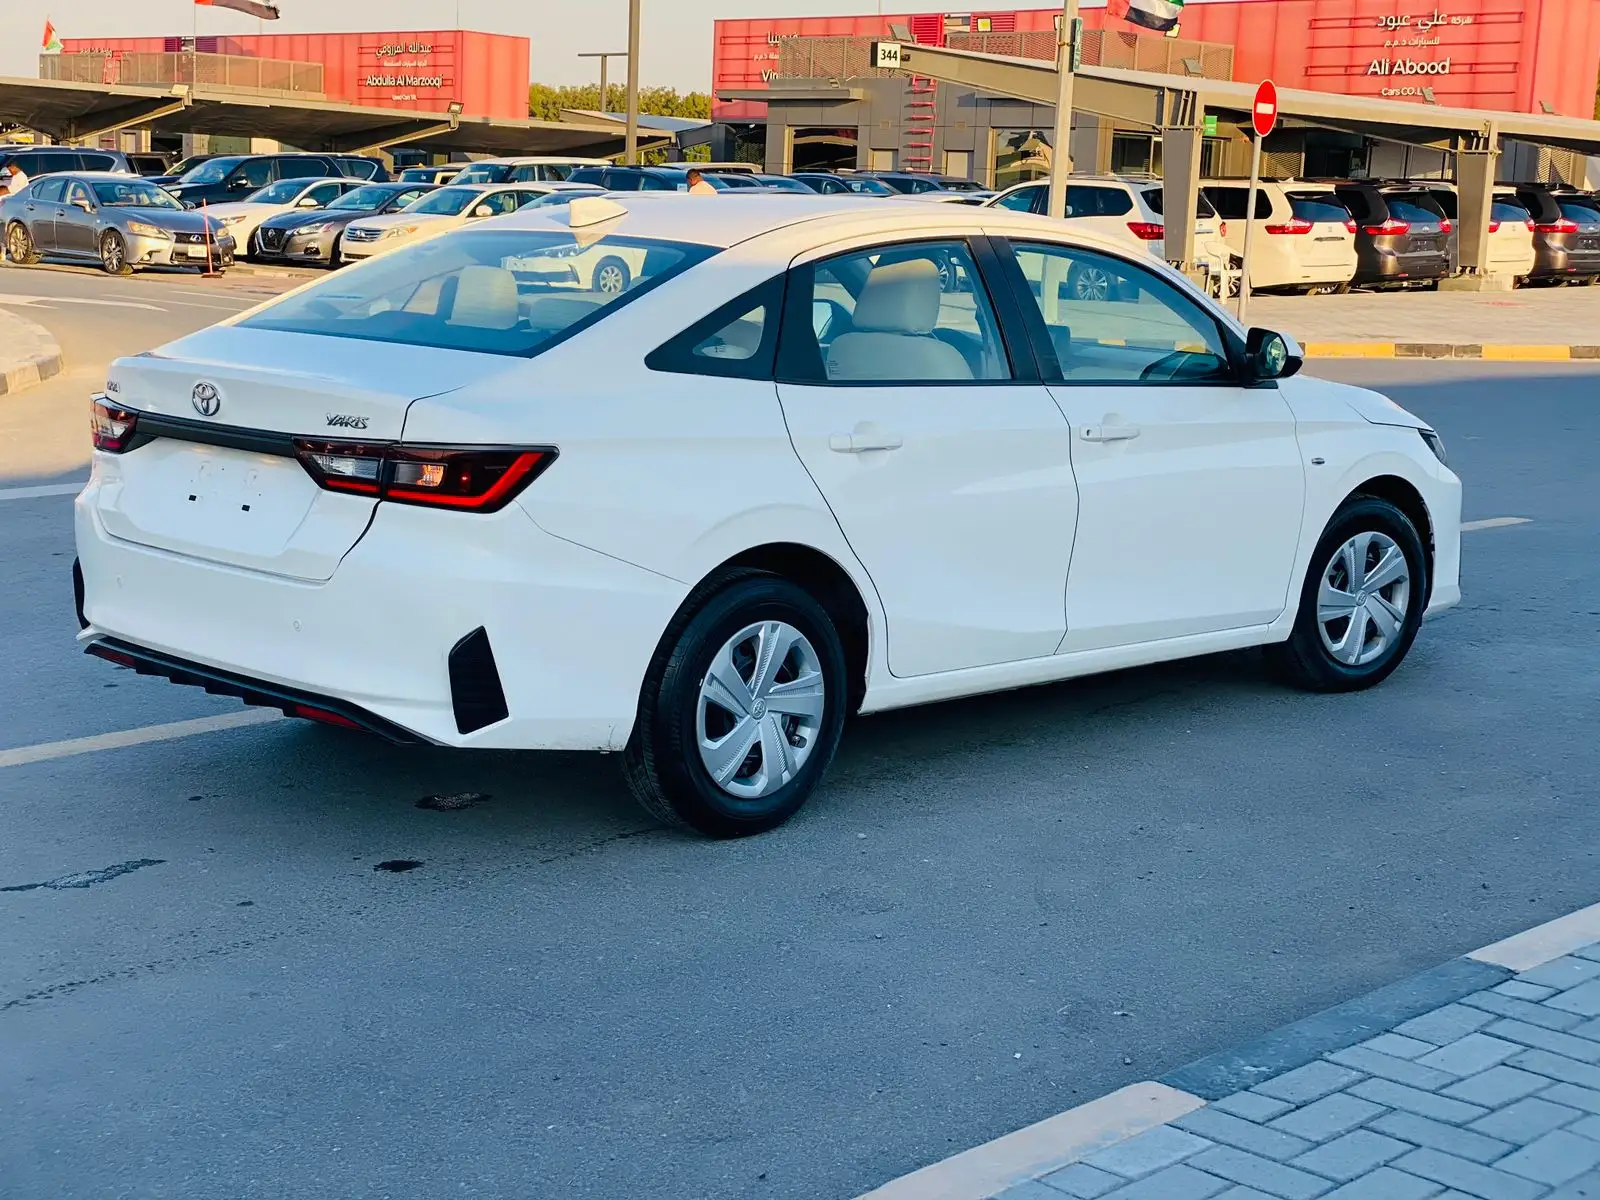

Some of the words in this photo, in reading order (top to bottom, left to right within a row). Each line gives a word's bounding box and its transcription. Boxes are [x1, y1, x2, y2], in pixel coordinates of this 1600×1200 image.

[1378, 15, 1411, 31] عبود
[1418, 8, 1449, 33] علي
[880, 49, 898, 61] 344
[1367, 58, 1389, 75] Ali
[1391, 57, 1451, 75] Abood
[366, 74, 395, 87] Abdulla
[396, 75, 405, 87] Al
[406, 74, 443, 89] Marzooqi
[1381, 87, 1401, 96] Cars
[327, 414, 370, 430] YARIS
